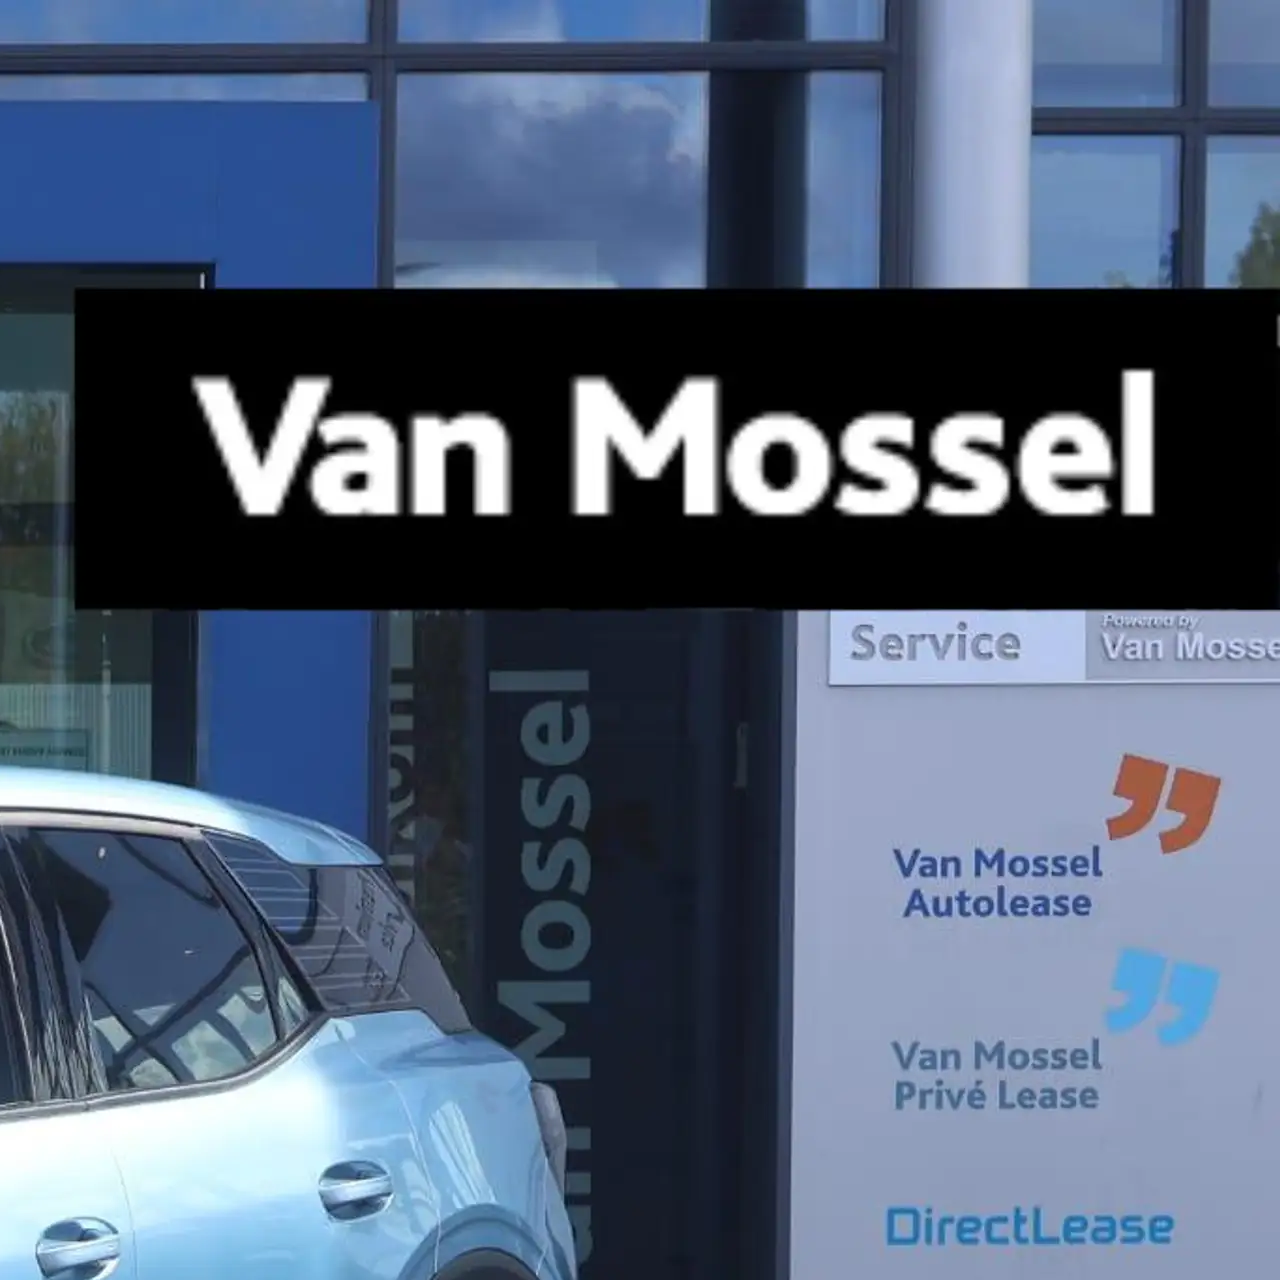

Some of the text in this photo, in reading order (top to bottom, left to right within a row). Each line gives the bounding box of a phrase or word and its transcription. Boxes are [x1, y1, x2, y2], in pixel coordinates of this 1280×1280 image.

[850, 621, 1021, 661] Service
[1100, 632, 1280, 662] Van Mosse
[488, 669, 594, 1081] Mossel
[892, 844, 1103, 879] Van Mossel
[903, 884, 1093, 919] Autolease
[890, 1037, 1103, 1071] Van Mossel
[894, 1078, 1100, 1111] Privé Lease
[885, 1206, 1176, 1246] DirectLease
